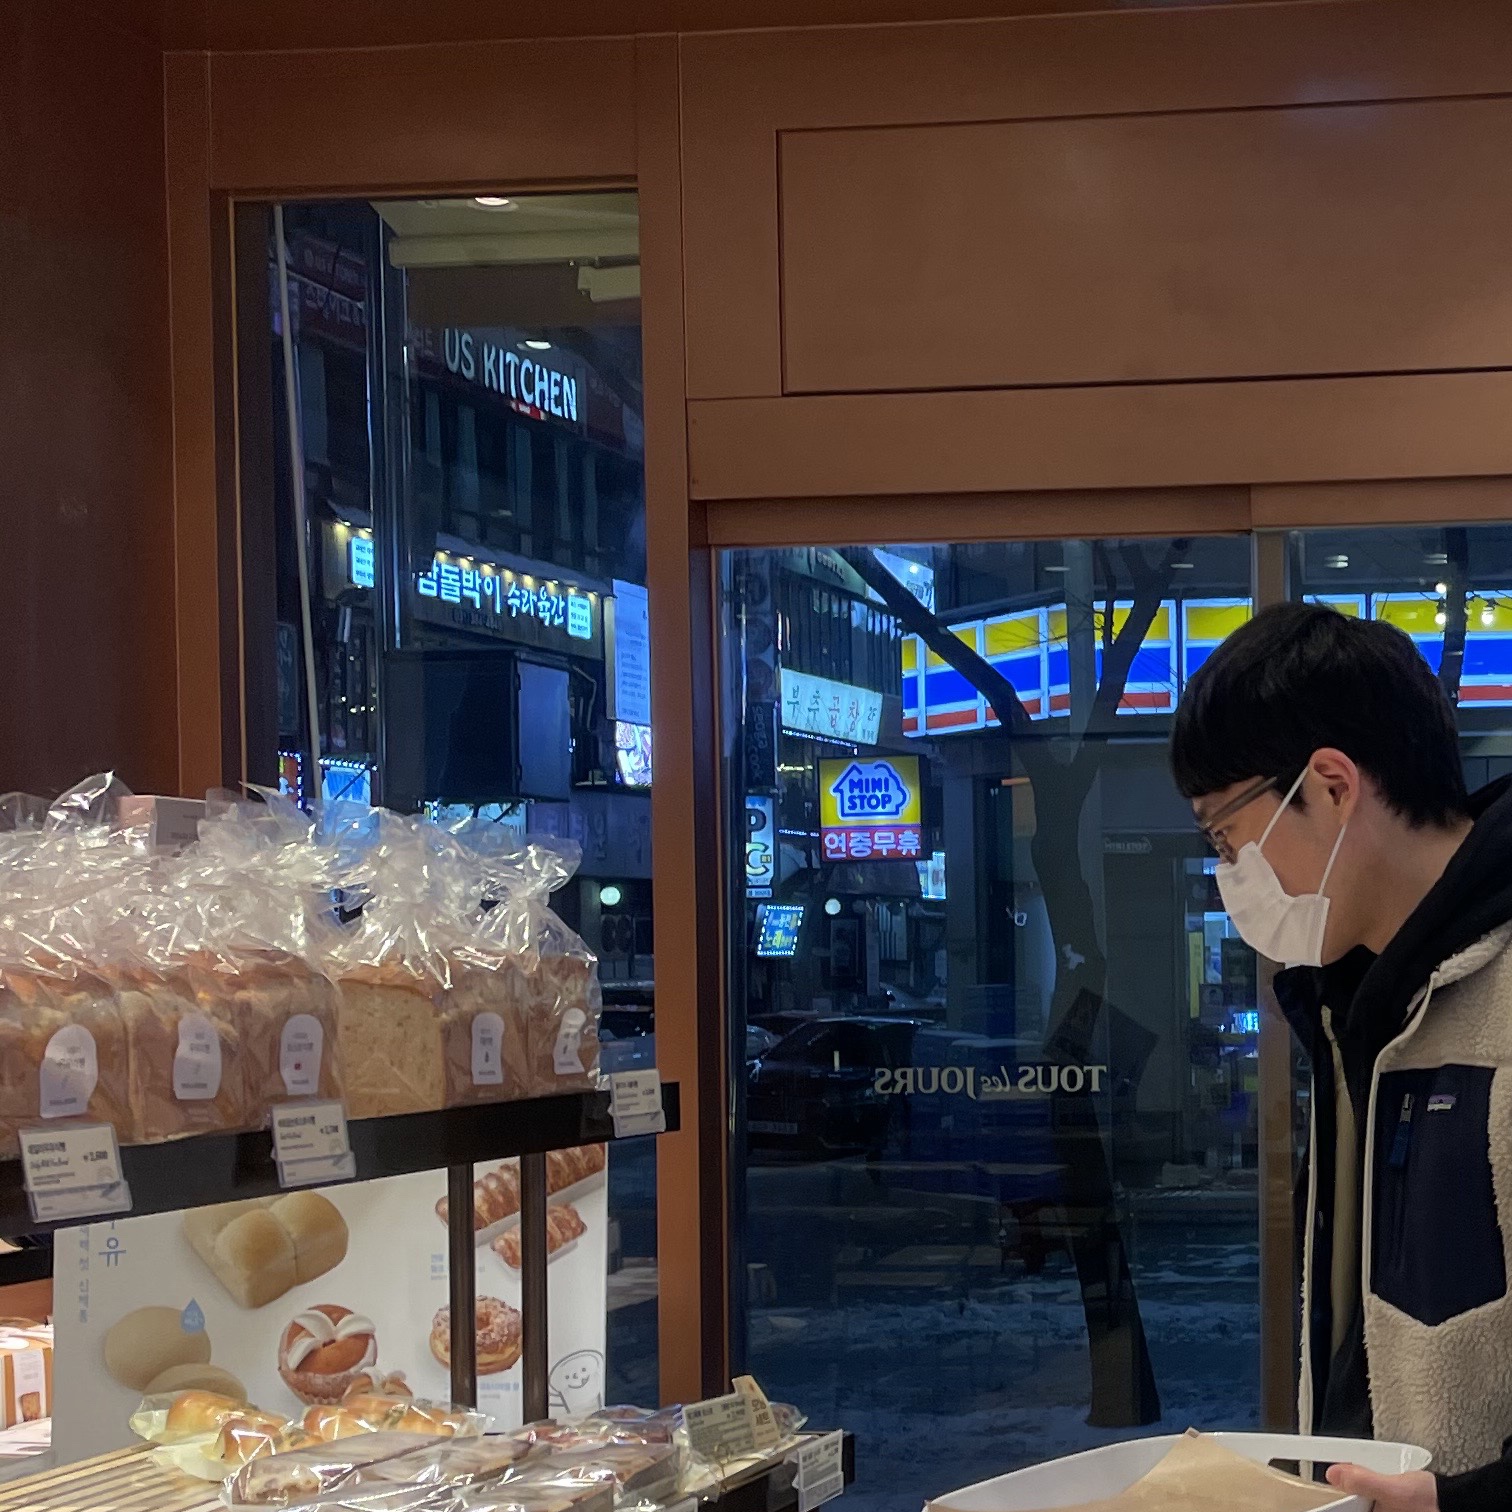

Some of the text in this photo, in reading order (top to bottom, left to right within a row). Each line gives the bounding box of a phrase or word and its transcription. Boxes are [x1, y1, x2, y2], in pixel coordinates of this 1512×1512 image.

[444, 327, 577, 422] US KITCHEN
[848, 777, 890, 794] MINI
[847, 794, 892, 811] STOP
[824, 829, 921, 860] 연중무휴
